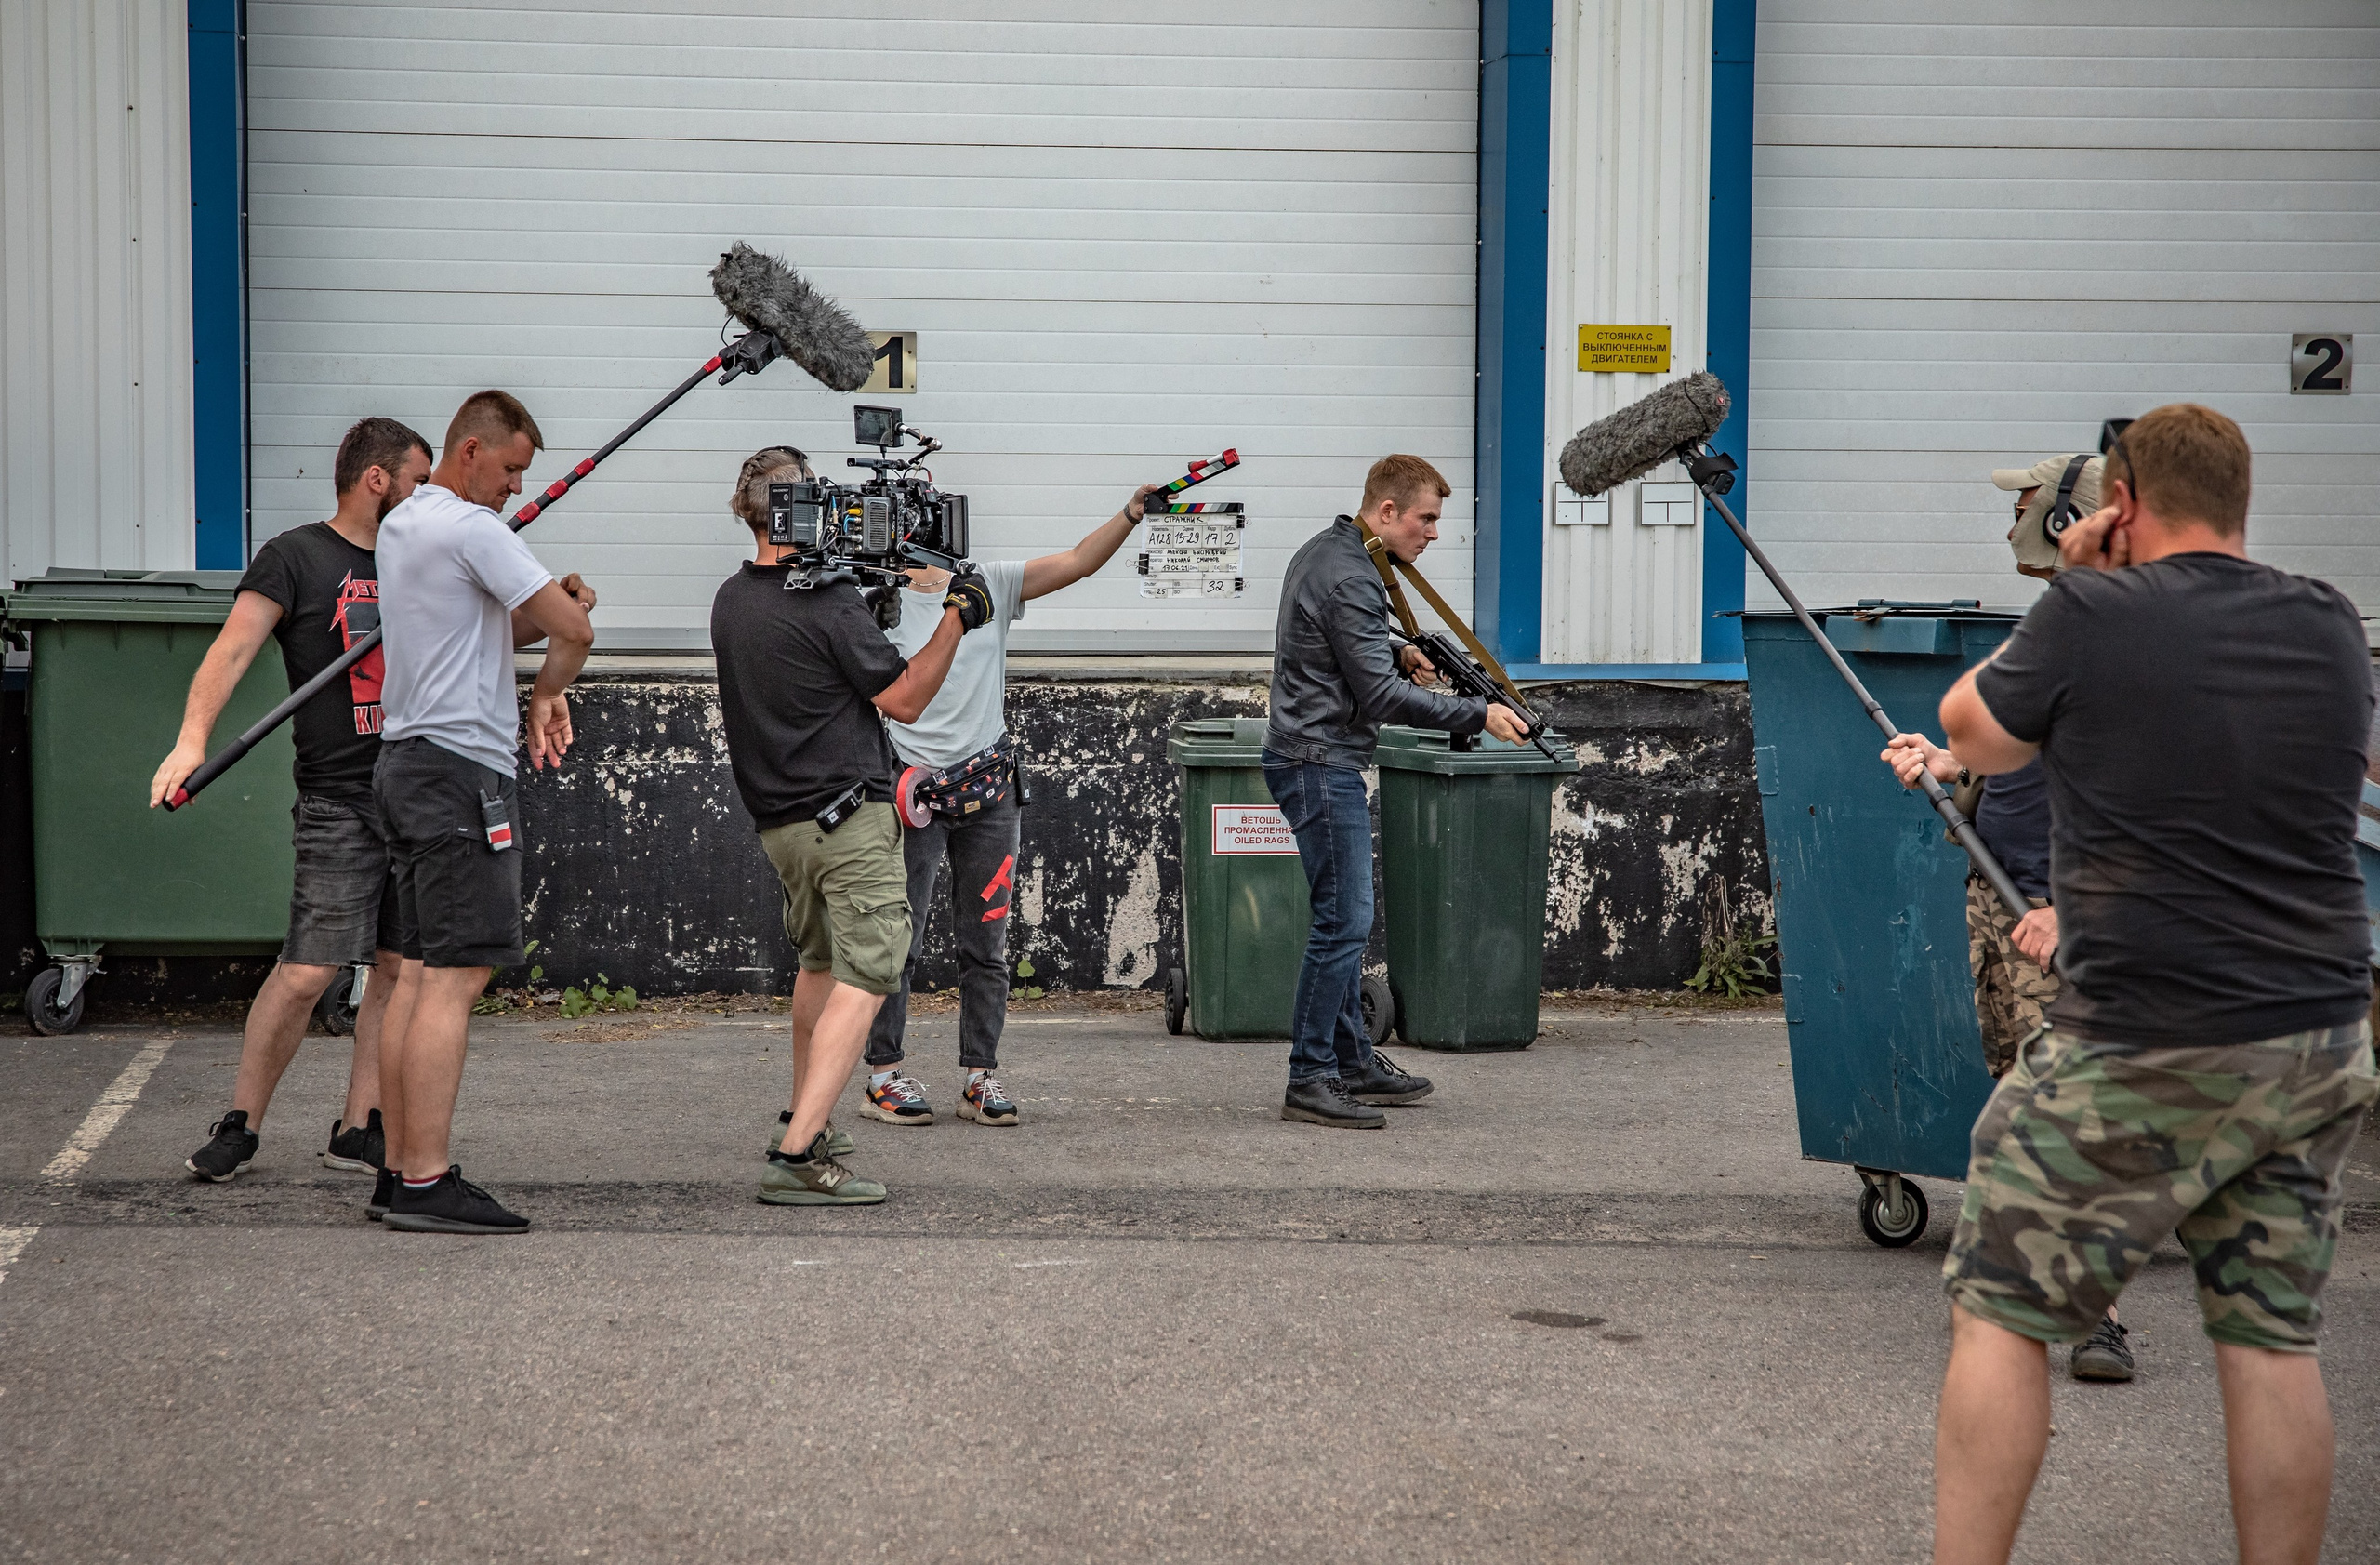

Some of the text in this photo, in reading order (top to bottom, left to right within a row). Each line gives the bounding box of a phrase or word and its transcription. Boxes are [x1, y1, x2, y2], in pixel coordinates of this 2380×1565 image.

[1597, 332, 1644, 340] СТОЯНКА
[1582, 343, 1667, 352] ВЫКЛЮЧЕННЫМ
[874, 336, 903, 388] 1
[1591, 354, 1658, 364] ДВИГАТЕЛЕМ
[2302, 338, 2343, 390] 2
[1205, 533, 1218, 545] 17
[1224, 532, 1236, 545] 2
[1207, 580, 1224, 593] 32
[818, 1171, 840, 1188] N
